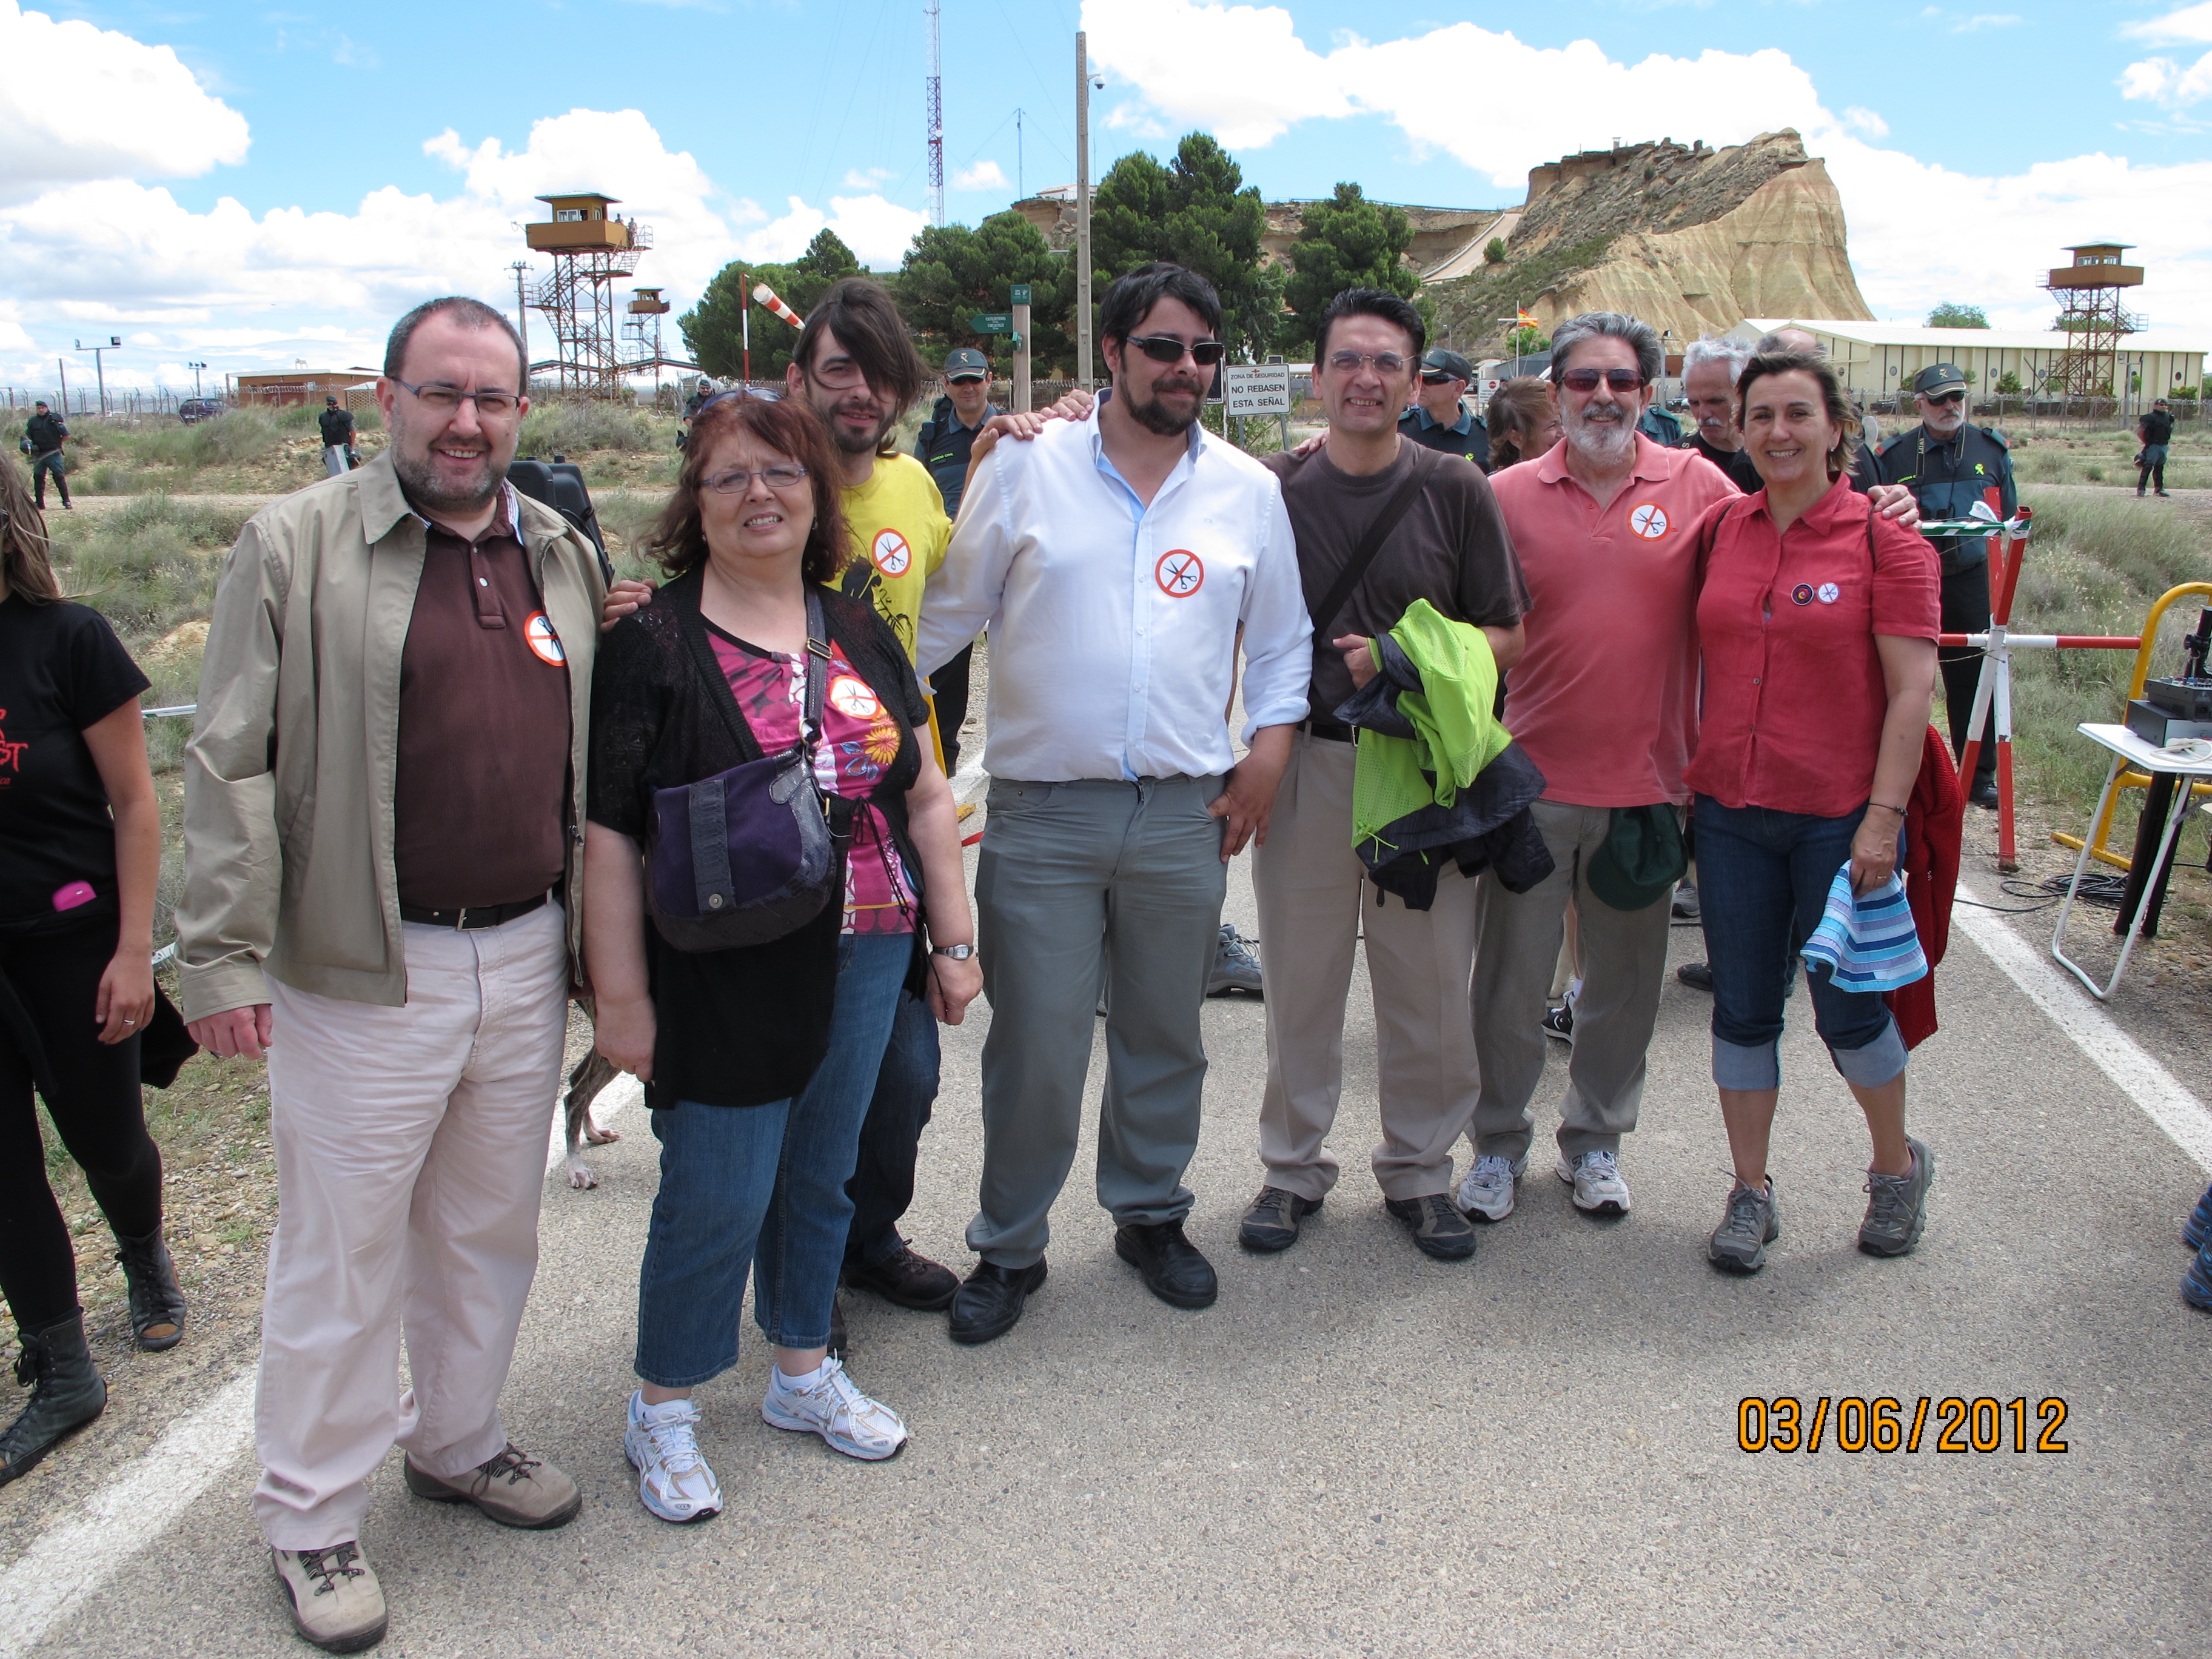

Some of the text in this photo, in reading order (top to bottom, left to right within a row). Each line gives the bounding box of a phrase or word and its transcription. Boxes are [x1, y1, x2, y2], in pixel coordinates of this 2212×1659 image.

[1247, 384, 1285, 393] REBASEN
[1233, 397, 1285, 408] ESTA SEÑAL
